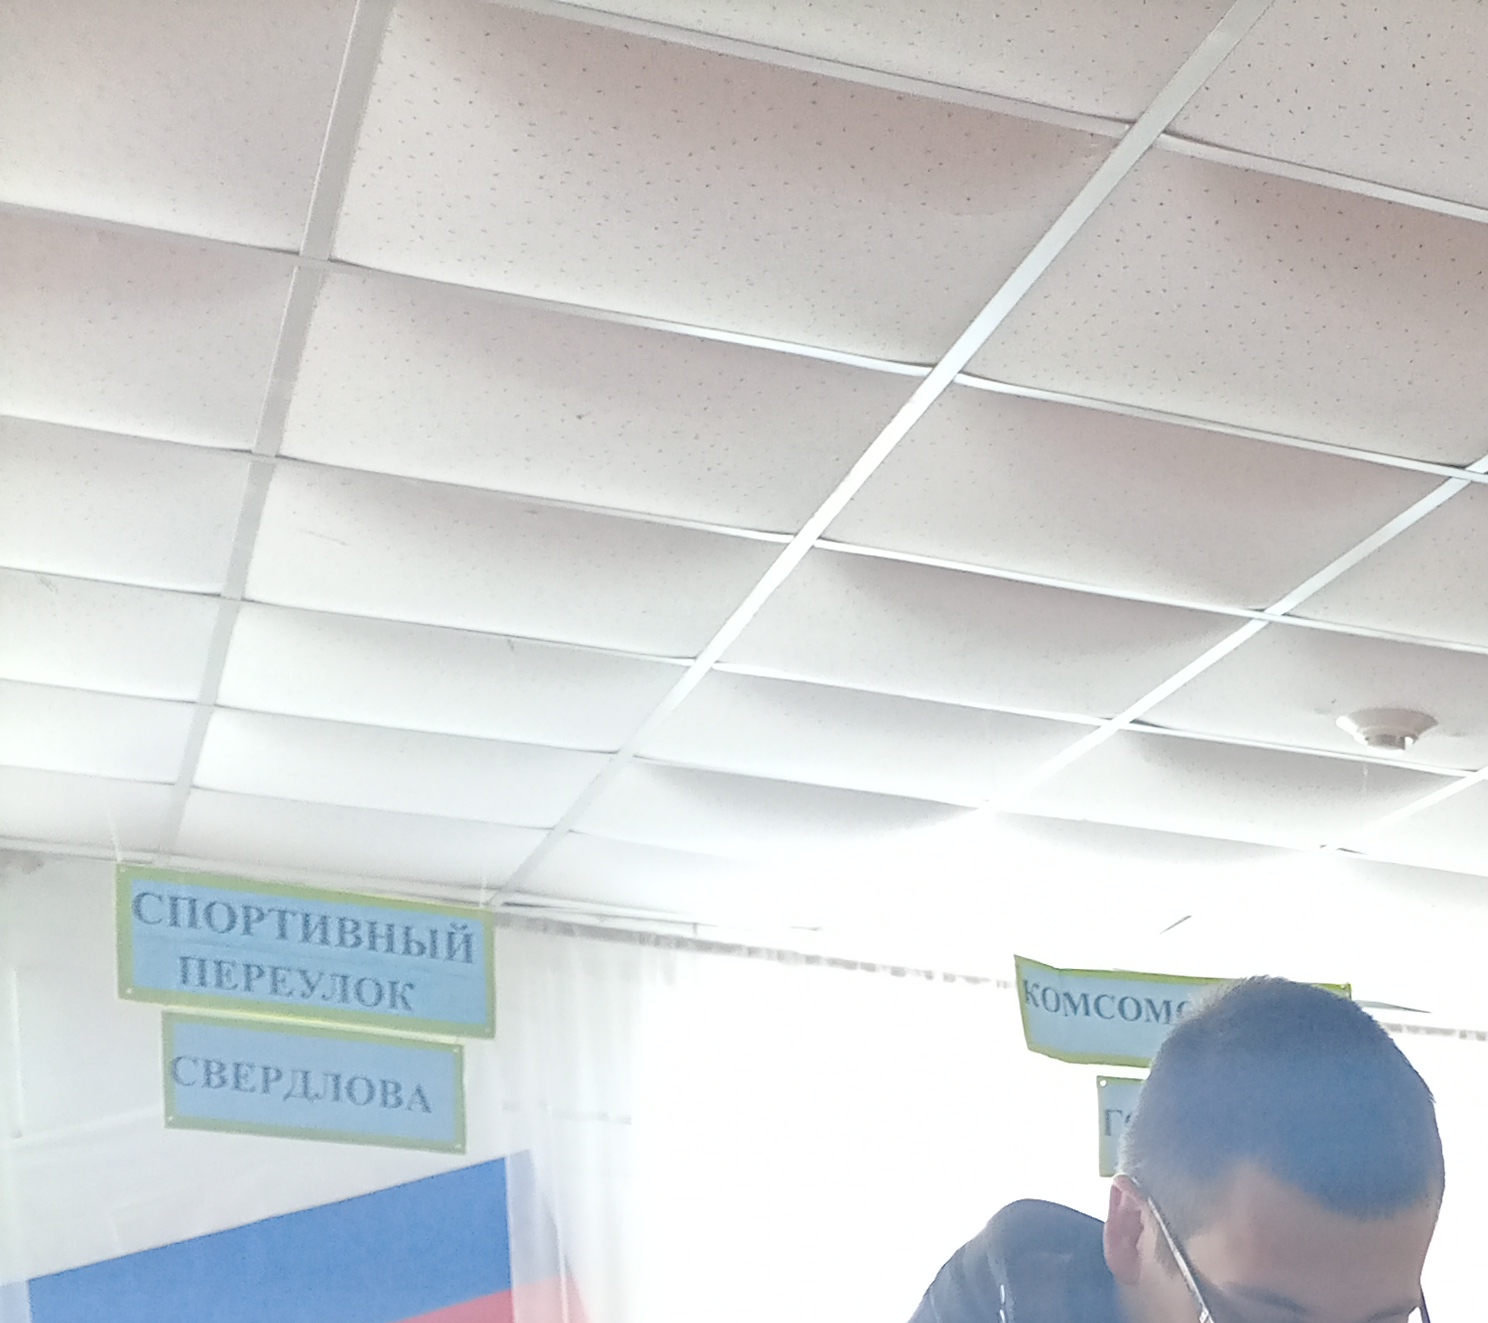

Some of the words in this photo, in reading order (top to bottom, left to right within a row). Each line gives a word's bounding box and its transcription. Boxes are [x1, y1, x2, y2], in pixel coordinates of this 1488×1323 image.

[133, 890, 476, 965] СПОРТИВНЫЙ
[178, 955, 416, 1013] ПЕРЕУЛОК
[170, 1055, 433, 1114] СВЕРДЛОВА
